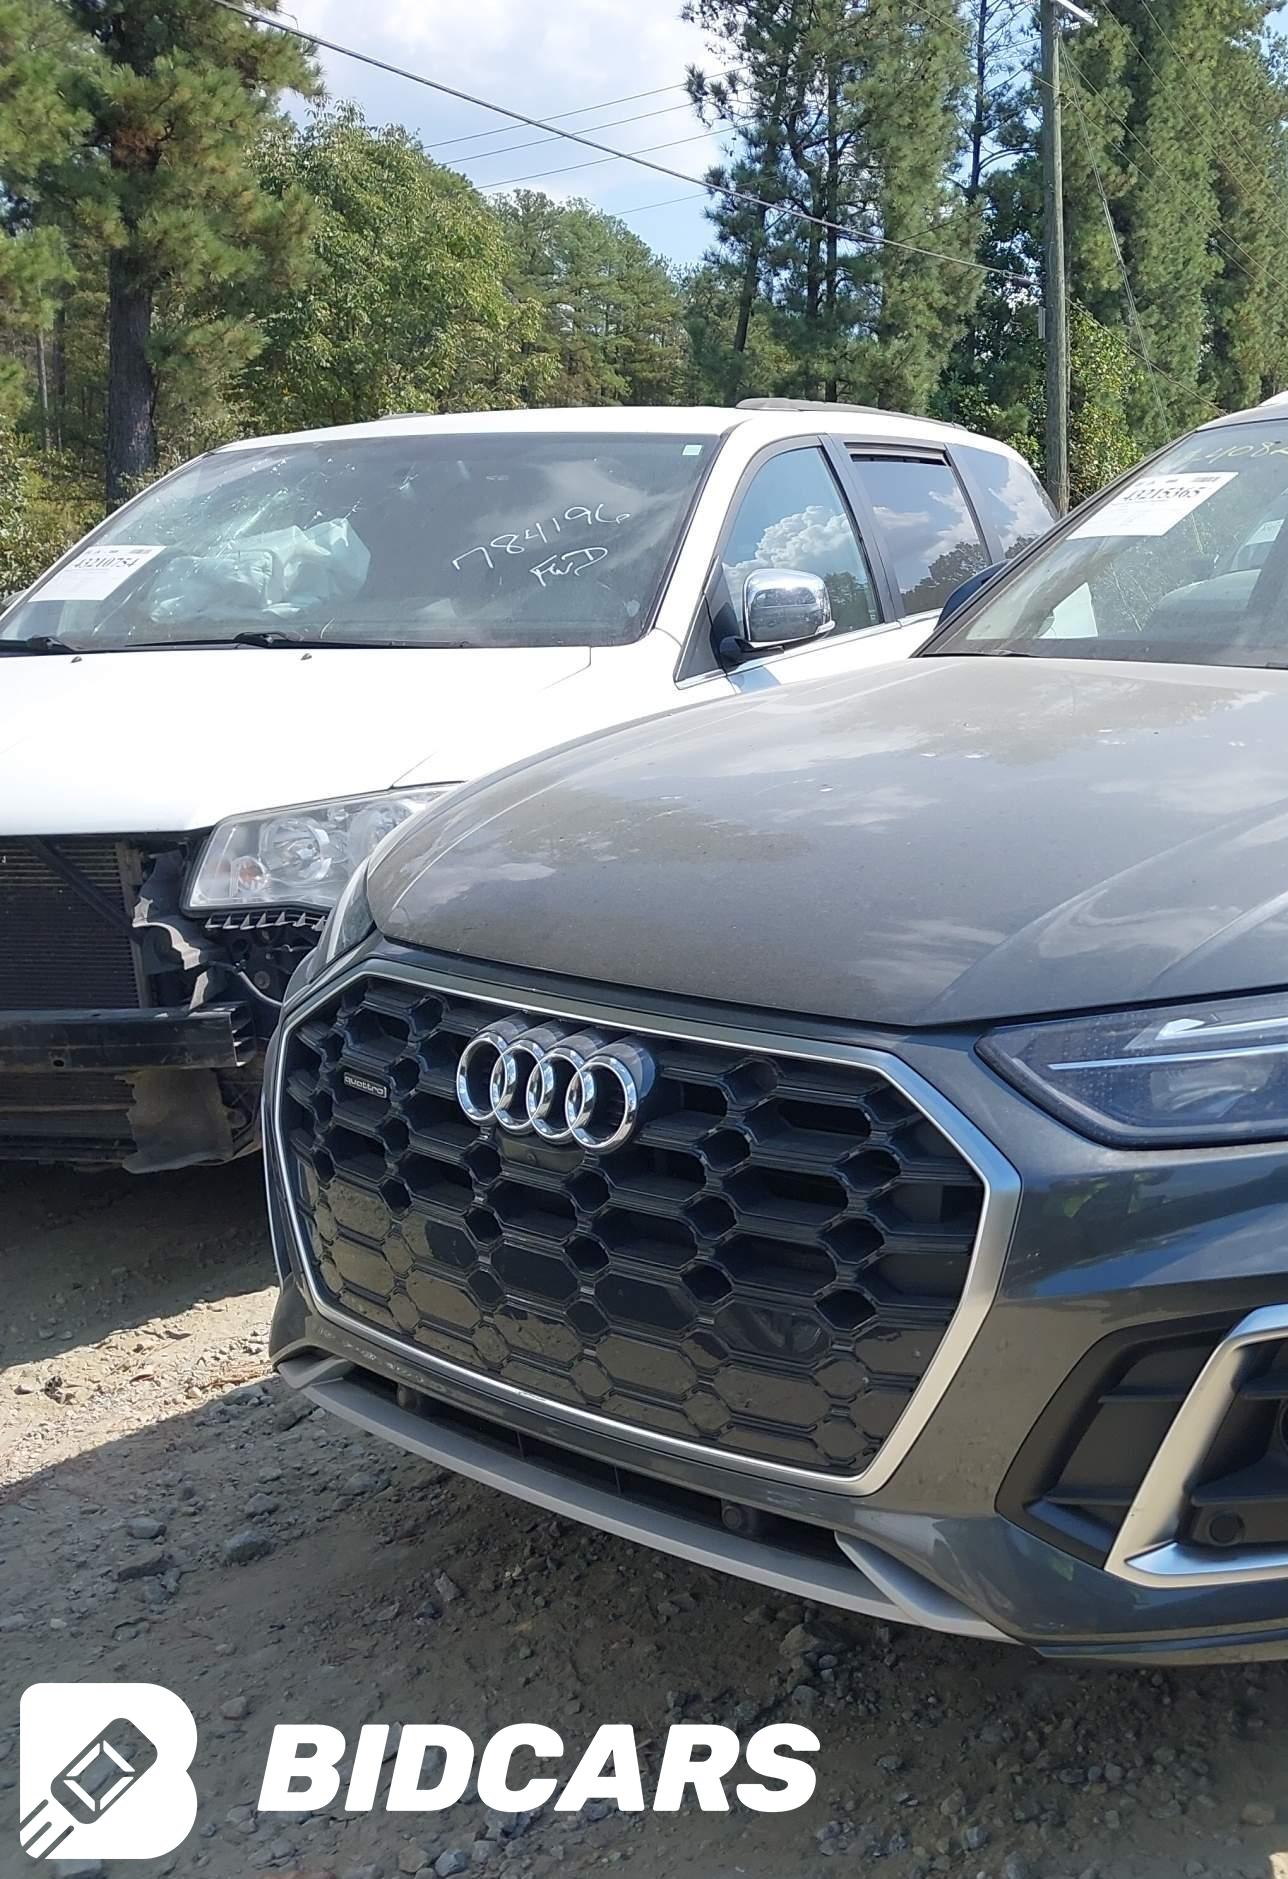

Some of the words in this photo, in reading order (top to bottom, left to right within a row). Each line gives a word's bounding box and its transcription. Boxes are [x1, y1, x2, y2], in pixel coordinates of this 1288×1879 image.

[452, 503, 631, 571] 784196
[73, 557, 140, 569] 43210754
[344, 1075, 385, 1096] quattro
